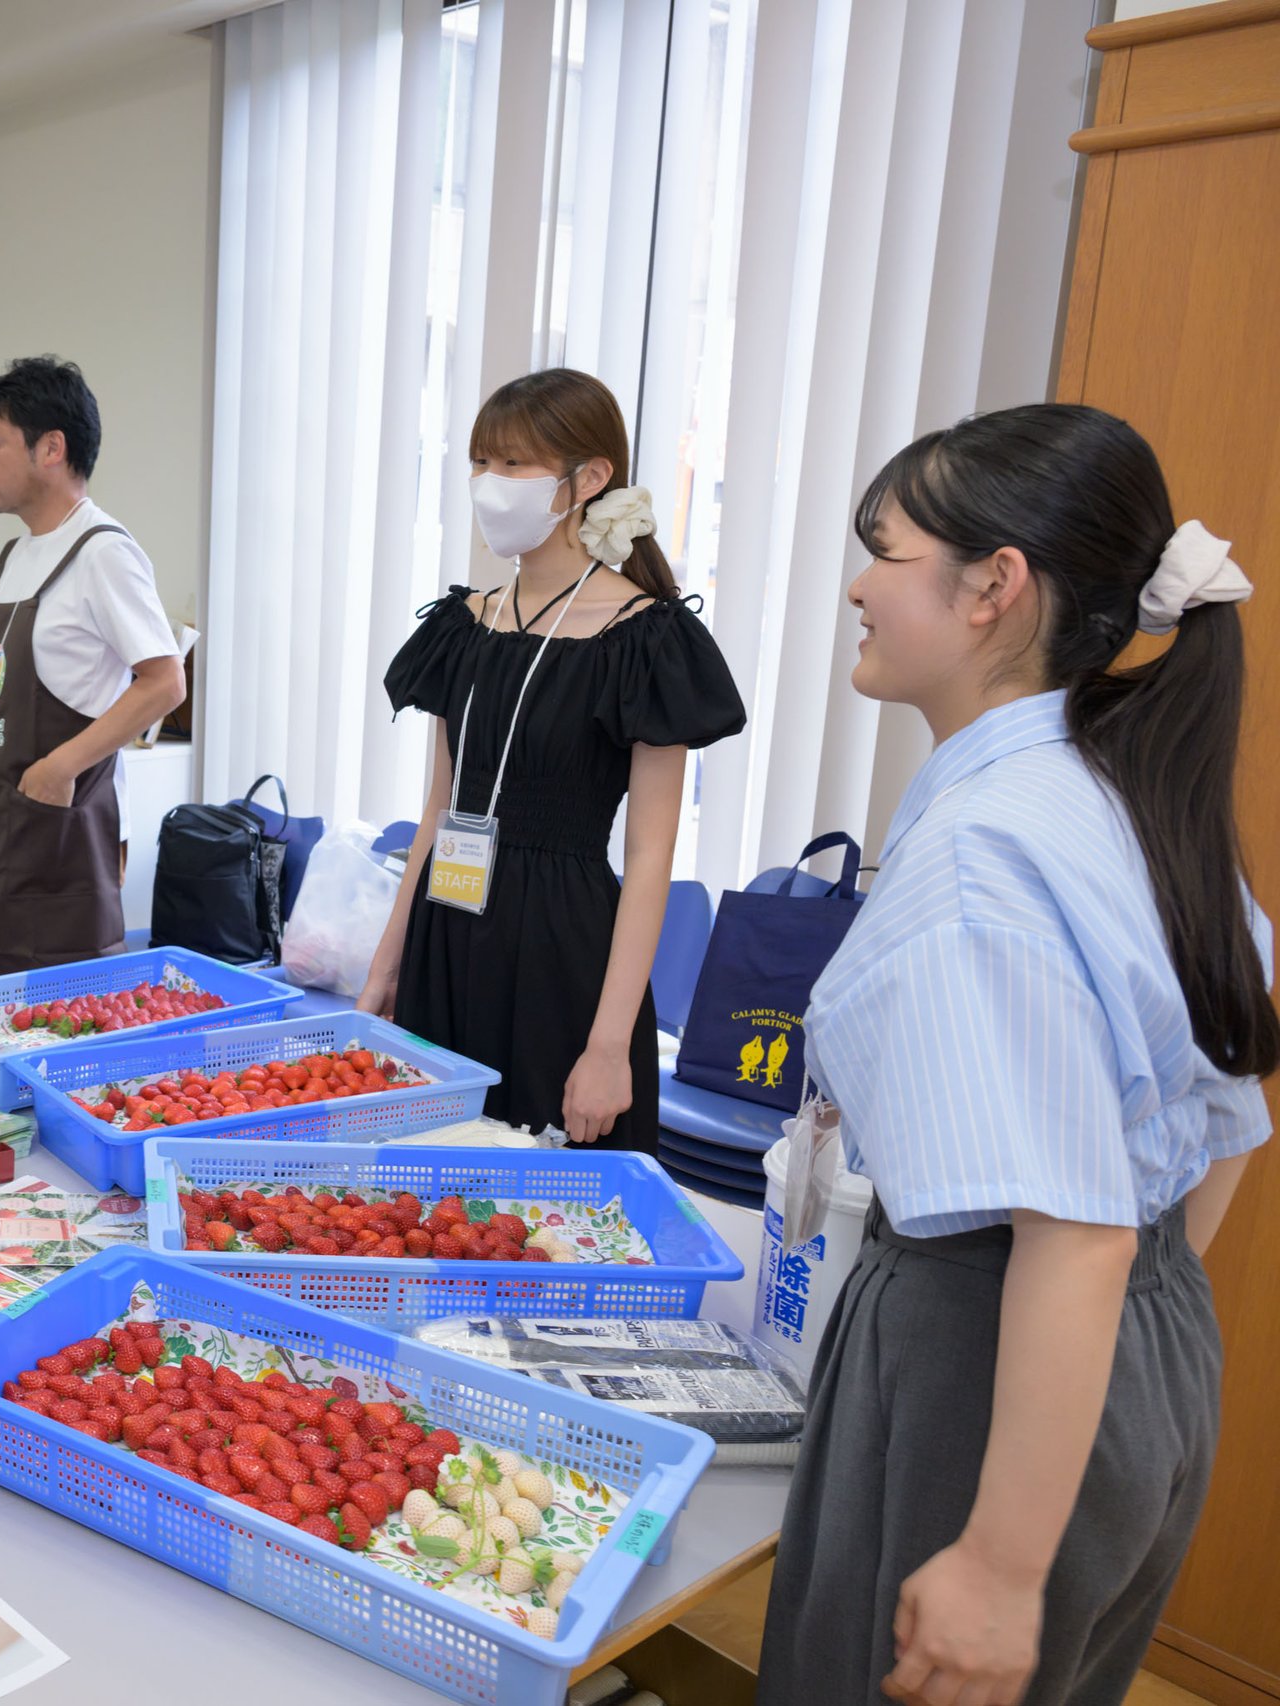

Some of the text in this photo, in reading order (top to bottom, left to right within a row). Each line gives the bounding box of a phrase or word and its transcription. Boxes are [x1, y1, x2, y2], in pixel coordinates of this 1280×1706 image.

[433, 870, 482, 892] STAFF
[731, 1008, 803, 1026] CALAMVS GLAD
[751, 1018, 793, 1031] FORTIOR
[773, 1246, 813, 1333] 除菌
[772, 1319, 803, 1343] できる
